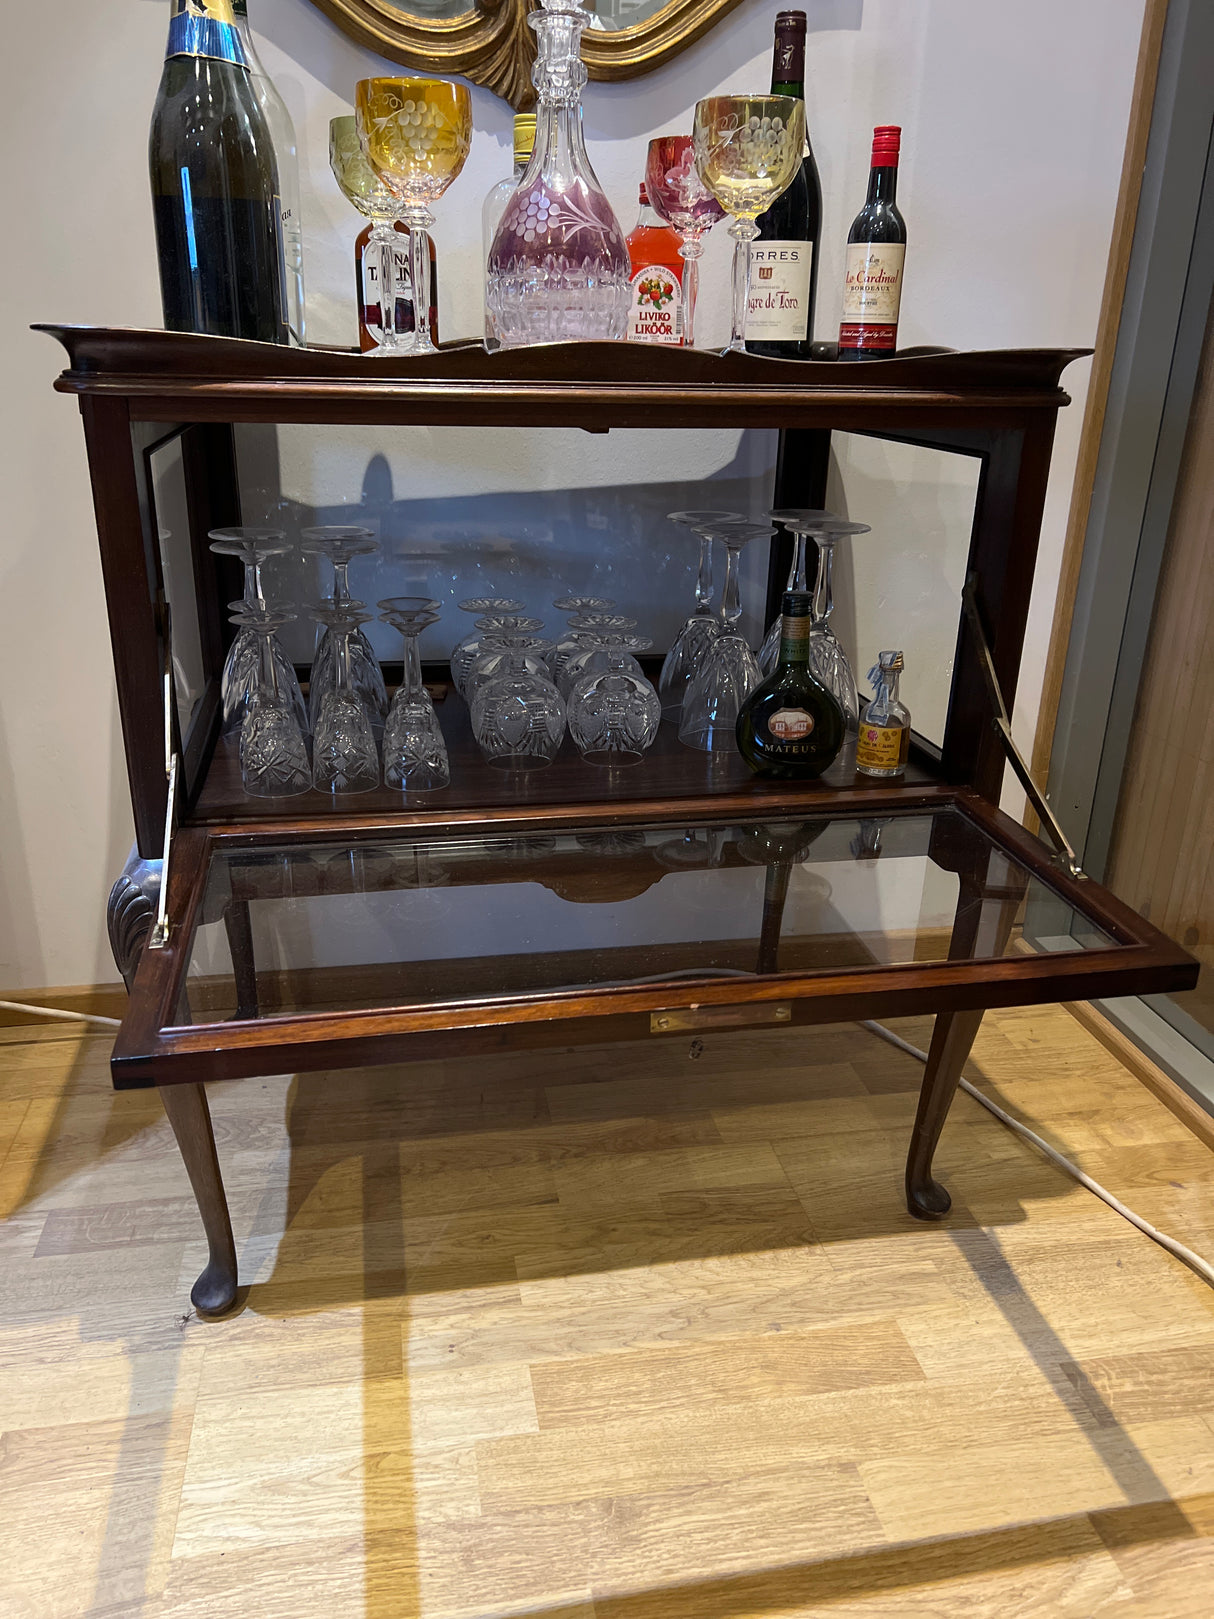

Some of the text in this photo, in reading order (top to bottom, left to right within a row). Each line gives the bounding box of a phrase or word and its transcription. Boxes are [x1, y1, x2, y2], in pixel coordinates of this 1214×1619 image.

[751, 251, 799, 261] RRES
[846, 268, 899, 284] Le Cardinal
[748, 290, 798, 313] gre de Toro
[639, 311, 671, 321] LIVIKO
[635, 322, 672, 335] LIKÖÖR
[764, 744, 817, 753] MATEUS
